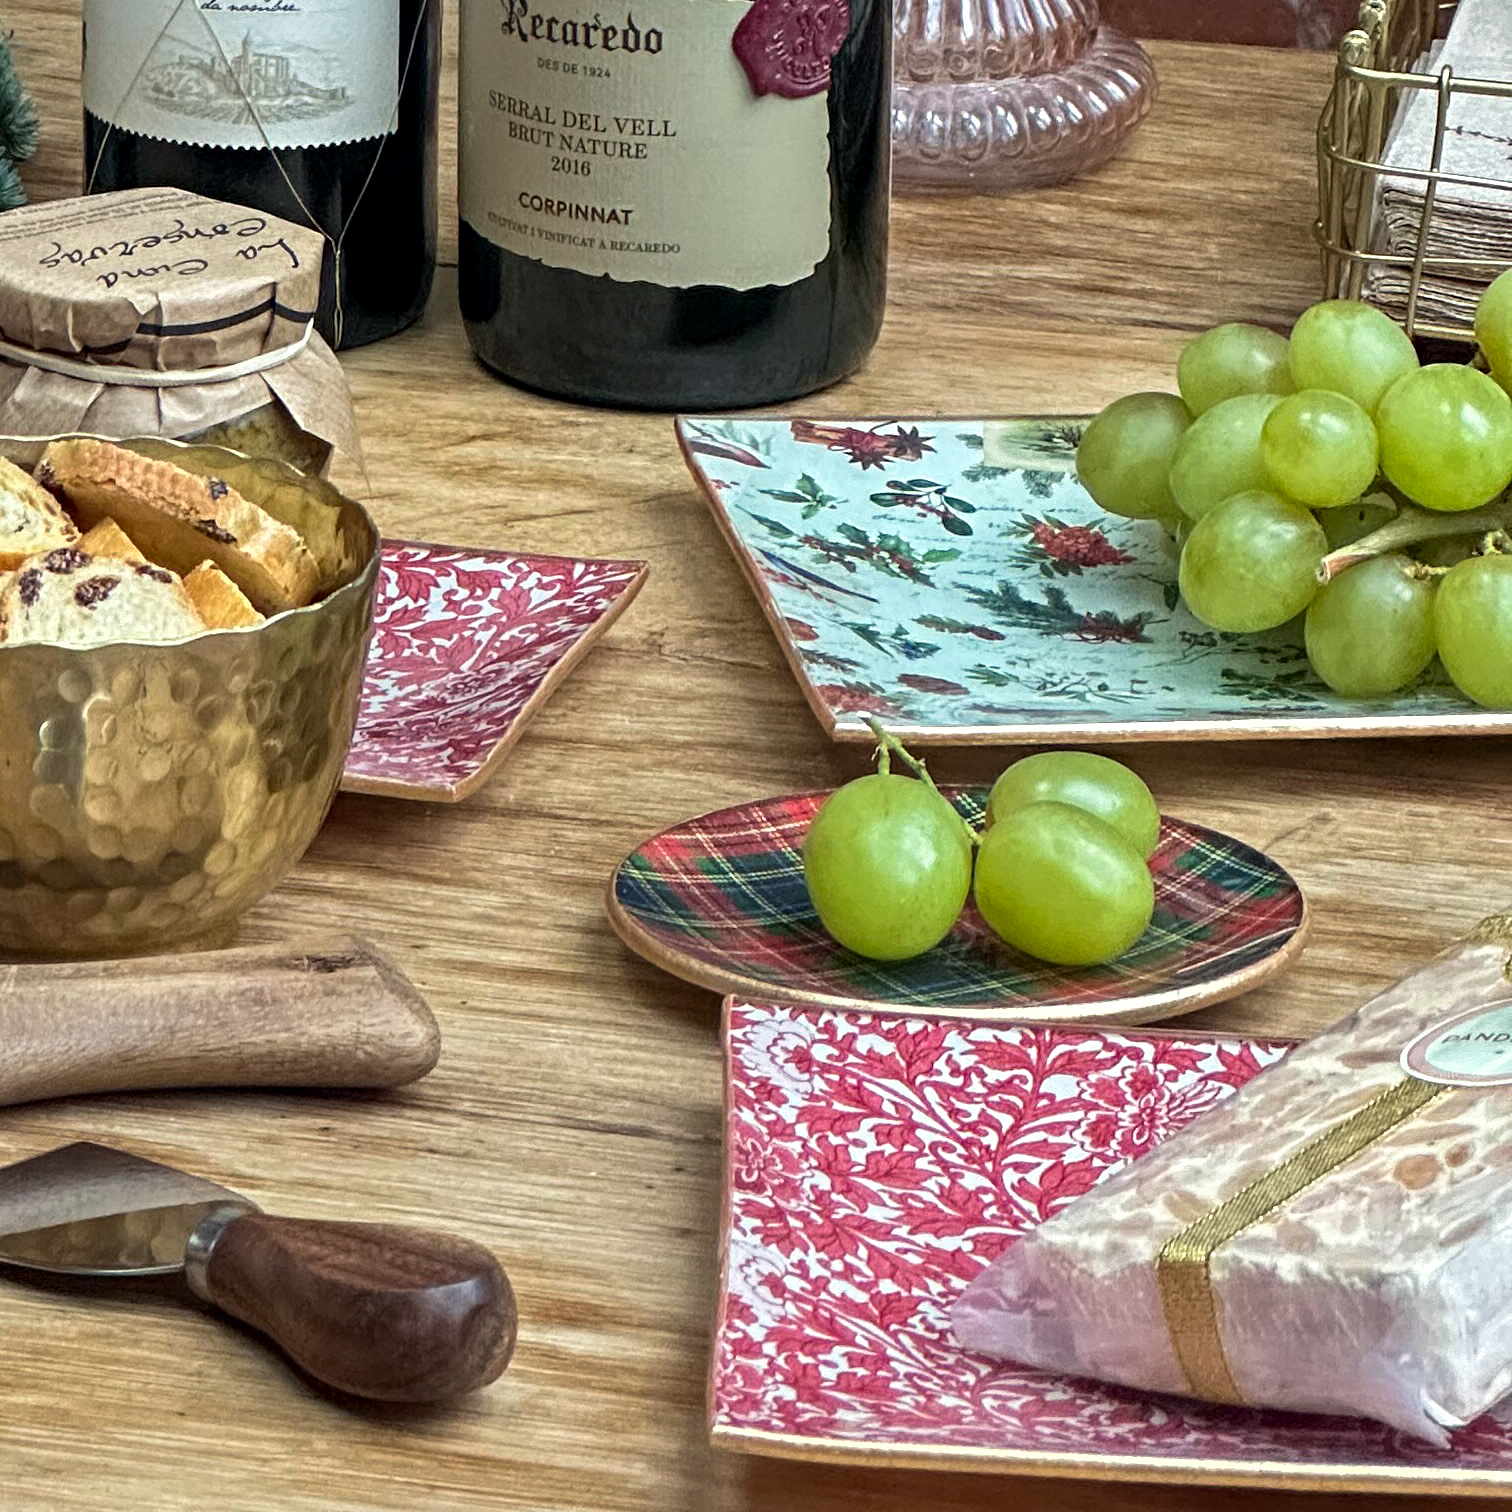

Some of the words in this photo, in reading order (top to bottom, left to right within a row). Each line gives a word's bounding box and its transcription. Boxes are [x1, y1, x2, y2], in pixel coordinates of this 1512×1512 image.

[200, 0, 224, 11] da
[228, 0, 302, 12] nombre
[538, 57, 560, 72] DES
[562, 62, 579, 75] DE
[582, 65, 612, 79] 1924
[488, 88, 557, 127] SERRAL
[562, 109, 608, 134] DEL
[613, 117, 678, 138] VELL
[508, 120, 555, 148] BRUT
[559, 133, 649, 160] NATURE
[551, 155, 592, 177] 2016
[519, 191, 634, 226] CORPINNAT
[235, 238, 300, 269] La
[609, 241, 681, 254] RECAREDO
[1442, 1033, 1512, 1043] PAND
